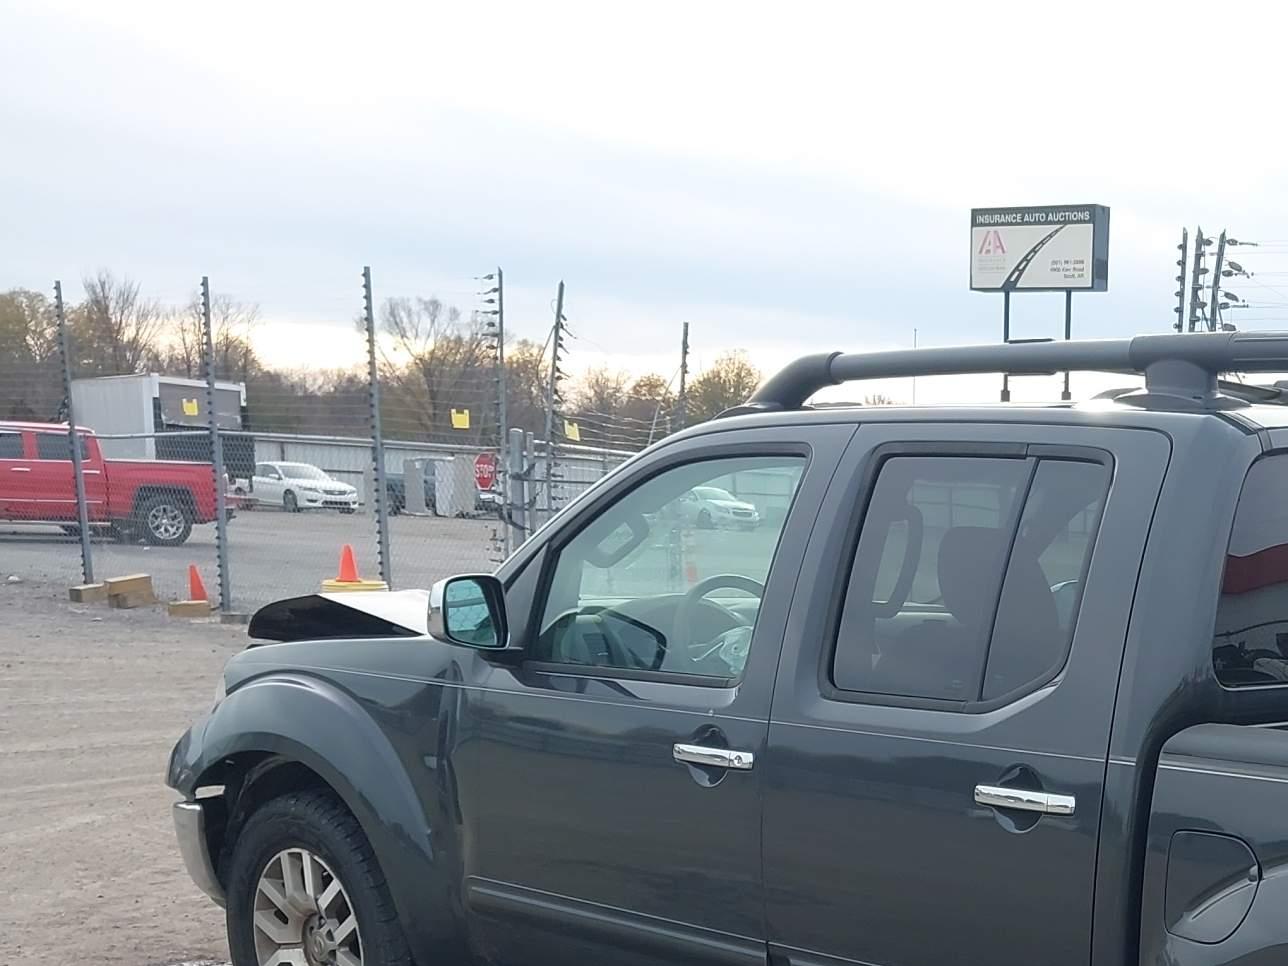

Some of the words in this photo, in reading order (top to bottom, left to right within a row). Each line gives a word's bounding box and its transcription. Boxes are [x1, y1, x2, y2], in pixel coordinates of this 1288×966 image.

[976, 213, 1022, 224] INSURANCE
[1023, 212, 1046, 222] AUTO
[1047, 211, 1090, 221] AUCTIONS
[476, 464, 494, 477] STOP
